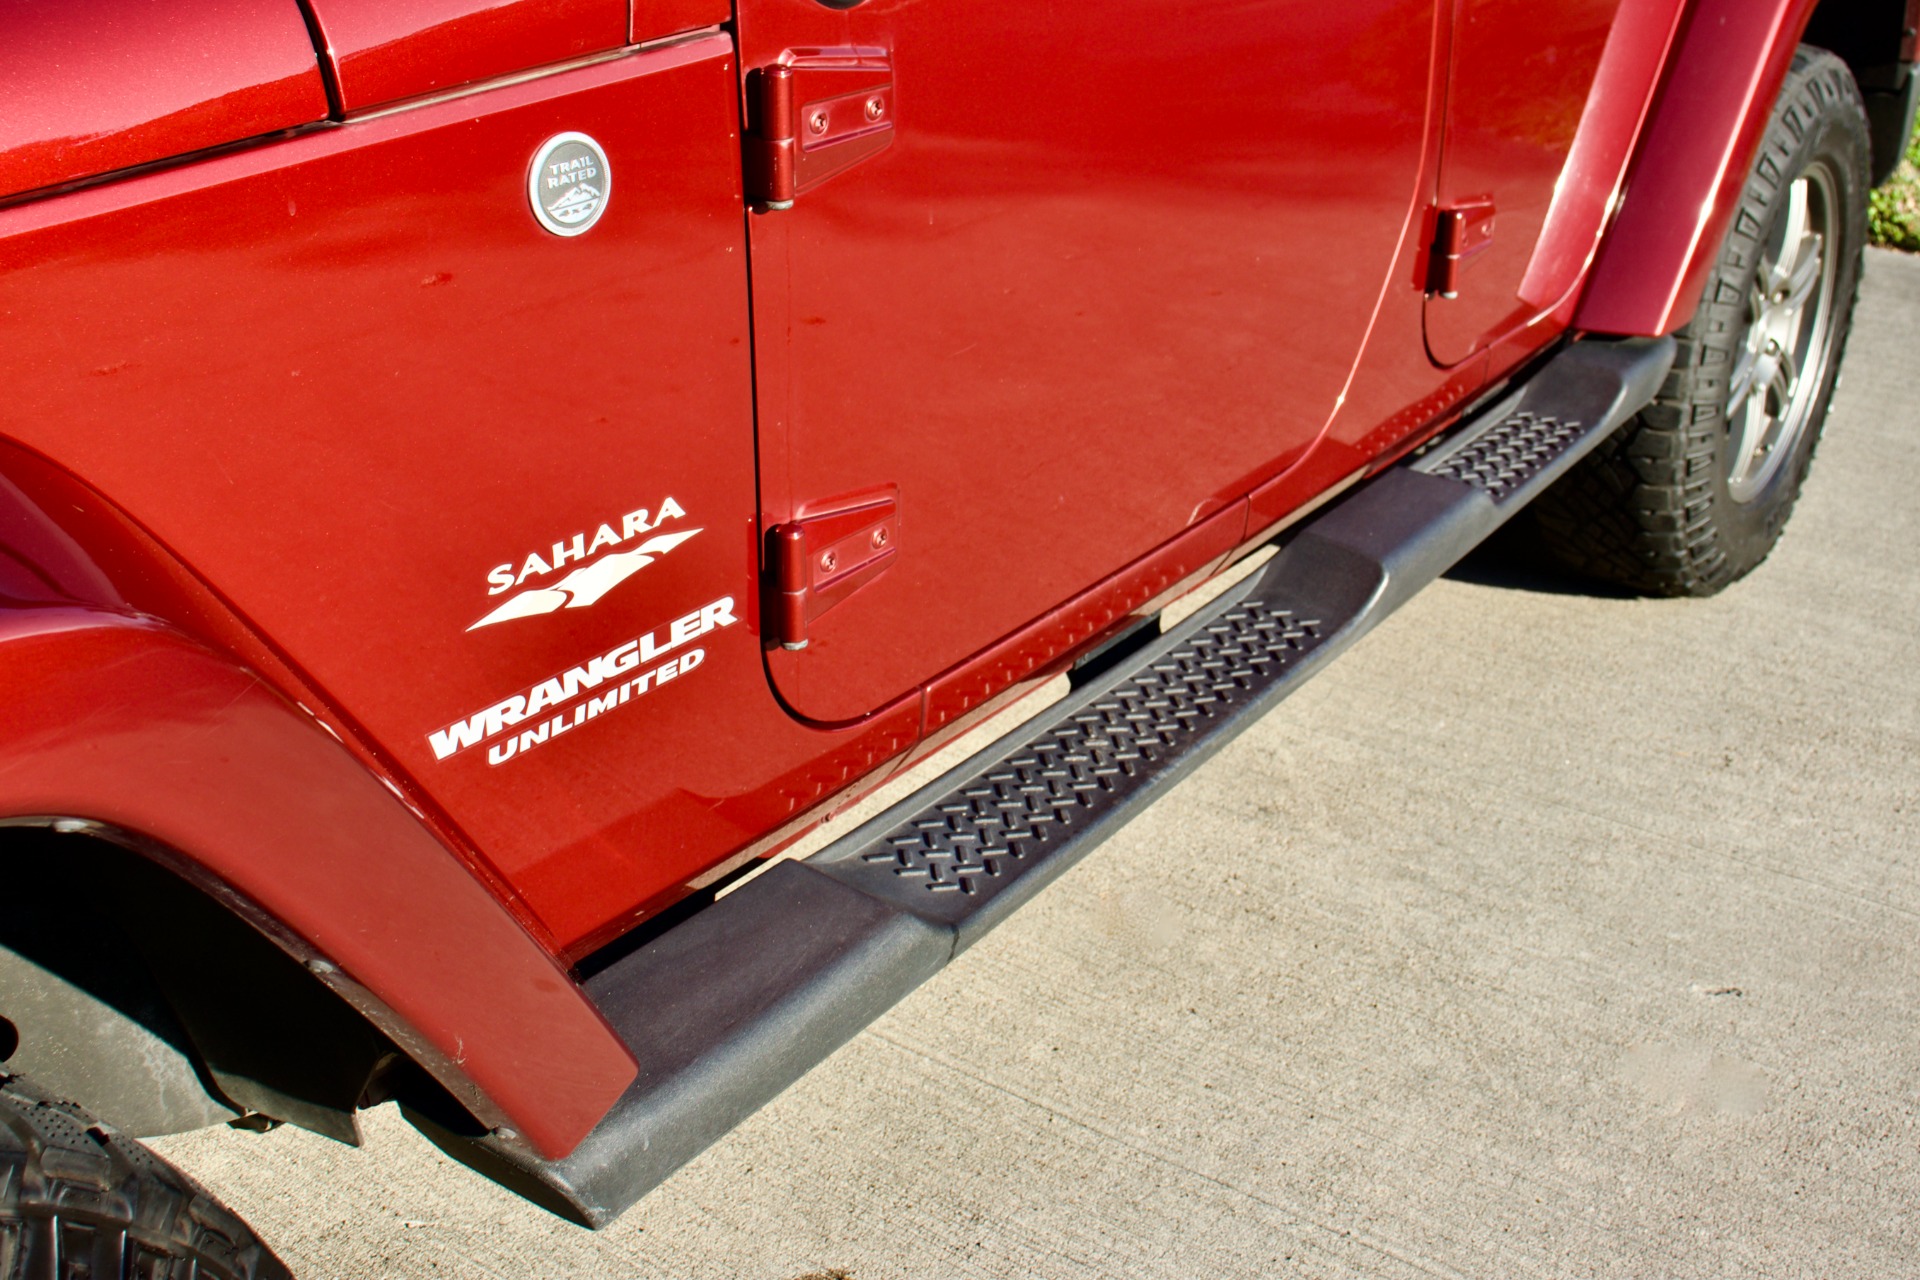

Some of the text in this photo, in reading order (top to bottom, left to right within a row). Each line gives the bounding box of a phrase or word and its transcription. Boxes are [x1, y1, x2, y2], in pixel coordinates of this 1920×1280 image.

[547, 167, 597, 189] RATED
[549, 155, 594, 175] TRAIL
[487, 496, 687, 596] SAHARA
[428, 596, 738, 760] WRANGLER
[488, 648, 706, 766] UNLIMITED
